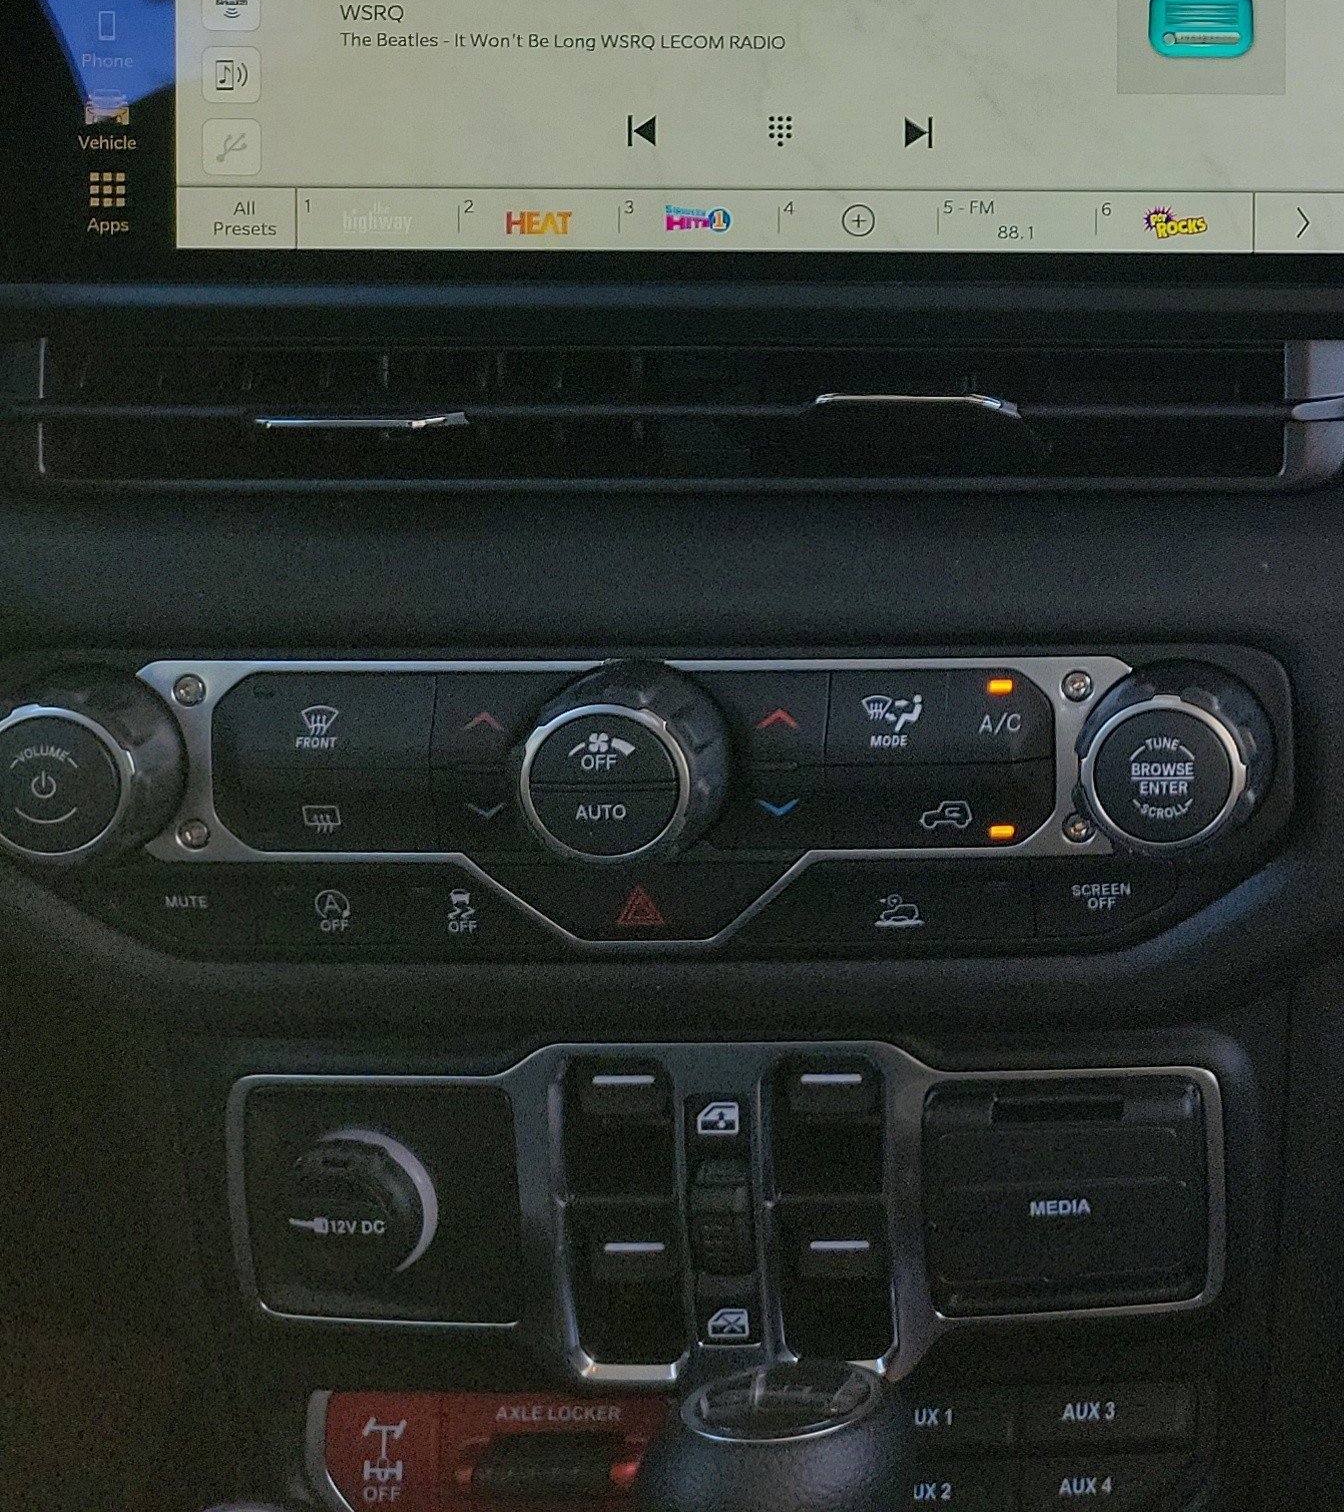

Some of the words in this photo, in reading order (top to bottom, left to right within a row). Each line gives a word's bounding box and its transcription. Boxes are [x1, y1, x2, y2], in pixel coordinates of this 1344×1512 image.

[340, 4, 404, 22] WSRQ
[340, 33, 371, 48] The
[377, 33, 438, 48] Beatles
[455, 34, 465, 48] It
[471, 34, 523, 49] Won't
[529, 34, 549, 49] Be
[554, 35, 596, 52] Long
[601, 35, 655, 51] WSRQ
[660, 35, 724, 49] LECOM
[729, 35, 785, 50] RADIO
[81, 52, 133, 69] Phone
[78, 134, 137, 151] Vehicle
[233, 201, 255, 216] All
[304, 199, 311, 213] 1
[464, 199, 474, 214] 2
[624, 200, 634, 215] 3
[783, 201, 795, 216] 4
[969, 200, 995, 215] FM
[1101, 202, 1112, 217] 6
[87, 217, 129, 235] Apps
[214, 221, 277, 237] Presets
[505, 210, 572, 235] HEAT
[1156, 217, 1208, 238] ROCKS
[998, 225, 1034, 240] 88.1
[979, 714, 1021, 734] A/C
[296, 737, 337, 749] FRONT
[870, 735, 908, 748] MODE
[1145, 737, 1180, 751] TUNE
[17, 745, 70, 762] VOLUME
[580, 753, 617, 770] OFF
[1131, 762, 1194, 776] BROWSE
[1140, 781, 1188, 795] ENTER
[575, 803, 626, 821] AUTO
[1140, 803, 1188, 819] SCROLL
[1072, 883, 1131, 896] SCREEN
[165, 896, 208, 909] MUTE
[1087, 897, 1116, 910] OFF
[320, 919, 349, 932] OFF
[448, 919, 477, 933] OFF
[1030, 1199, 1091, 1217] MEDIA
[331, 1220, 357, 1234] 12V
[361, 1220, 385, 1234] DC
[496, 1405, 543, 1421] AXLE
[548, 1405, 621, 1421] LOCKER
[914, 1409, 938, 1425] UX
[945, 1409, 953, 1425] 1
[1062, 1402, 1100, 1421] AUX
[1105, 1402, 1116, 1420] 3
[913, 1483, 937, 1500] UX
[941, 1483, 951, 1499] 2
[1059, 1477, 1097, 1496] AUX
[1101, 1476, 1112, 1493] 4
[363, 1487, 400, 1502] OFF
